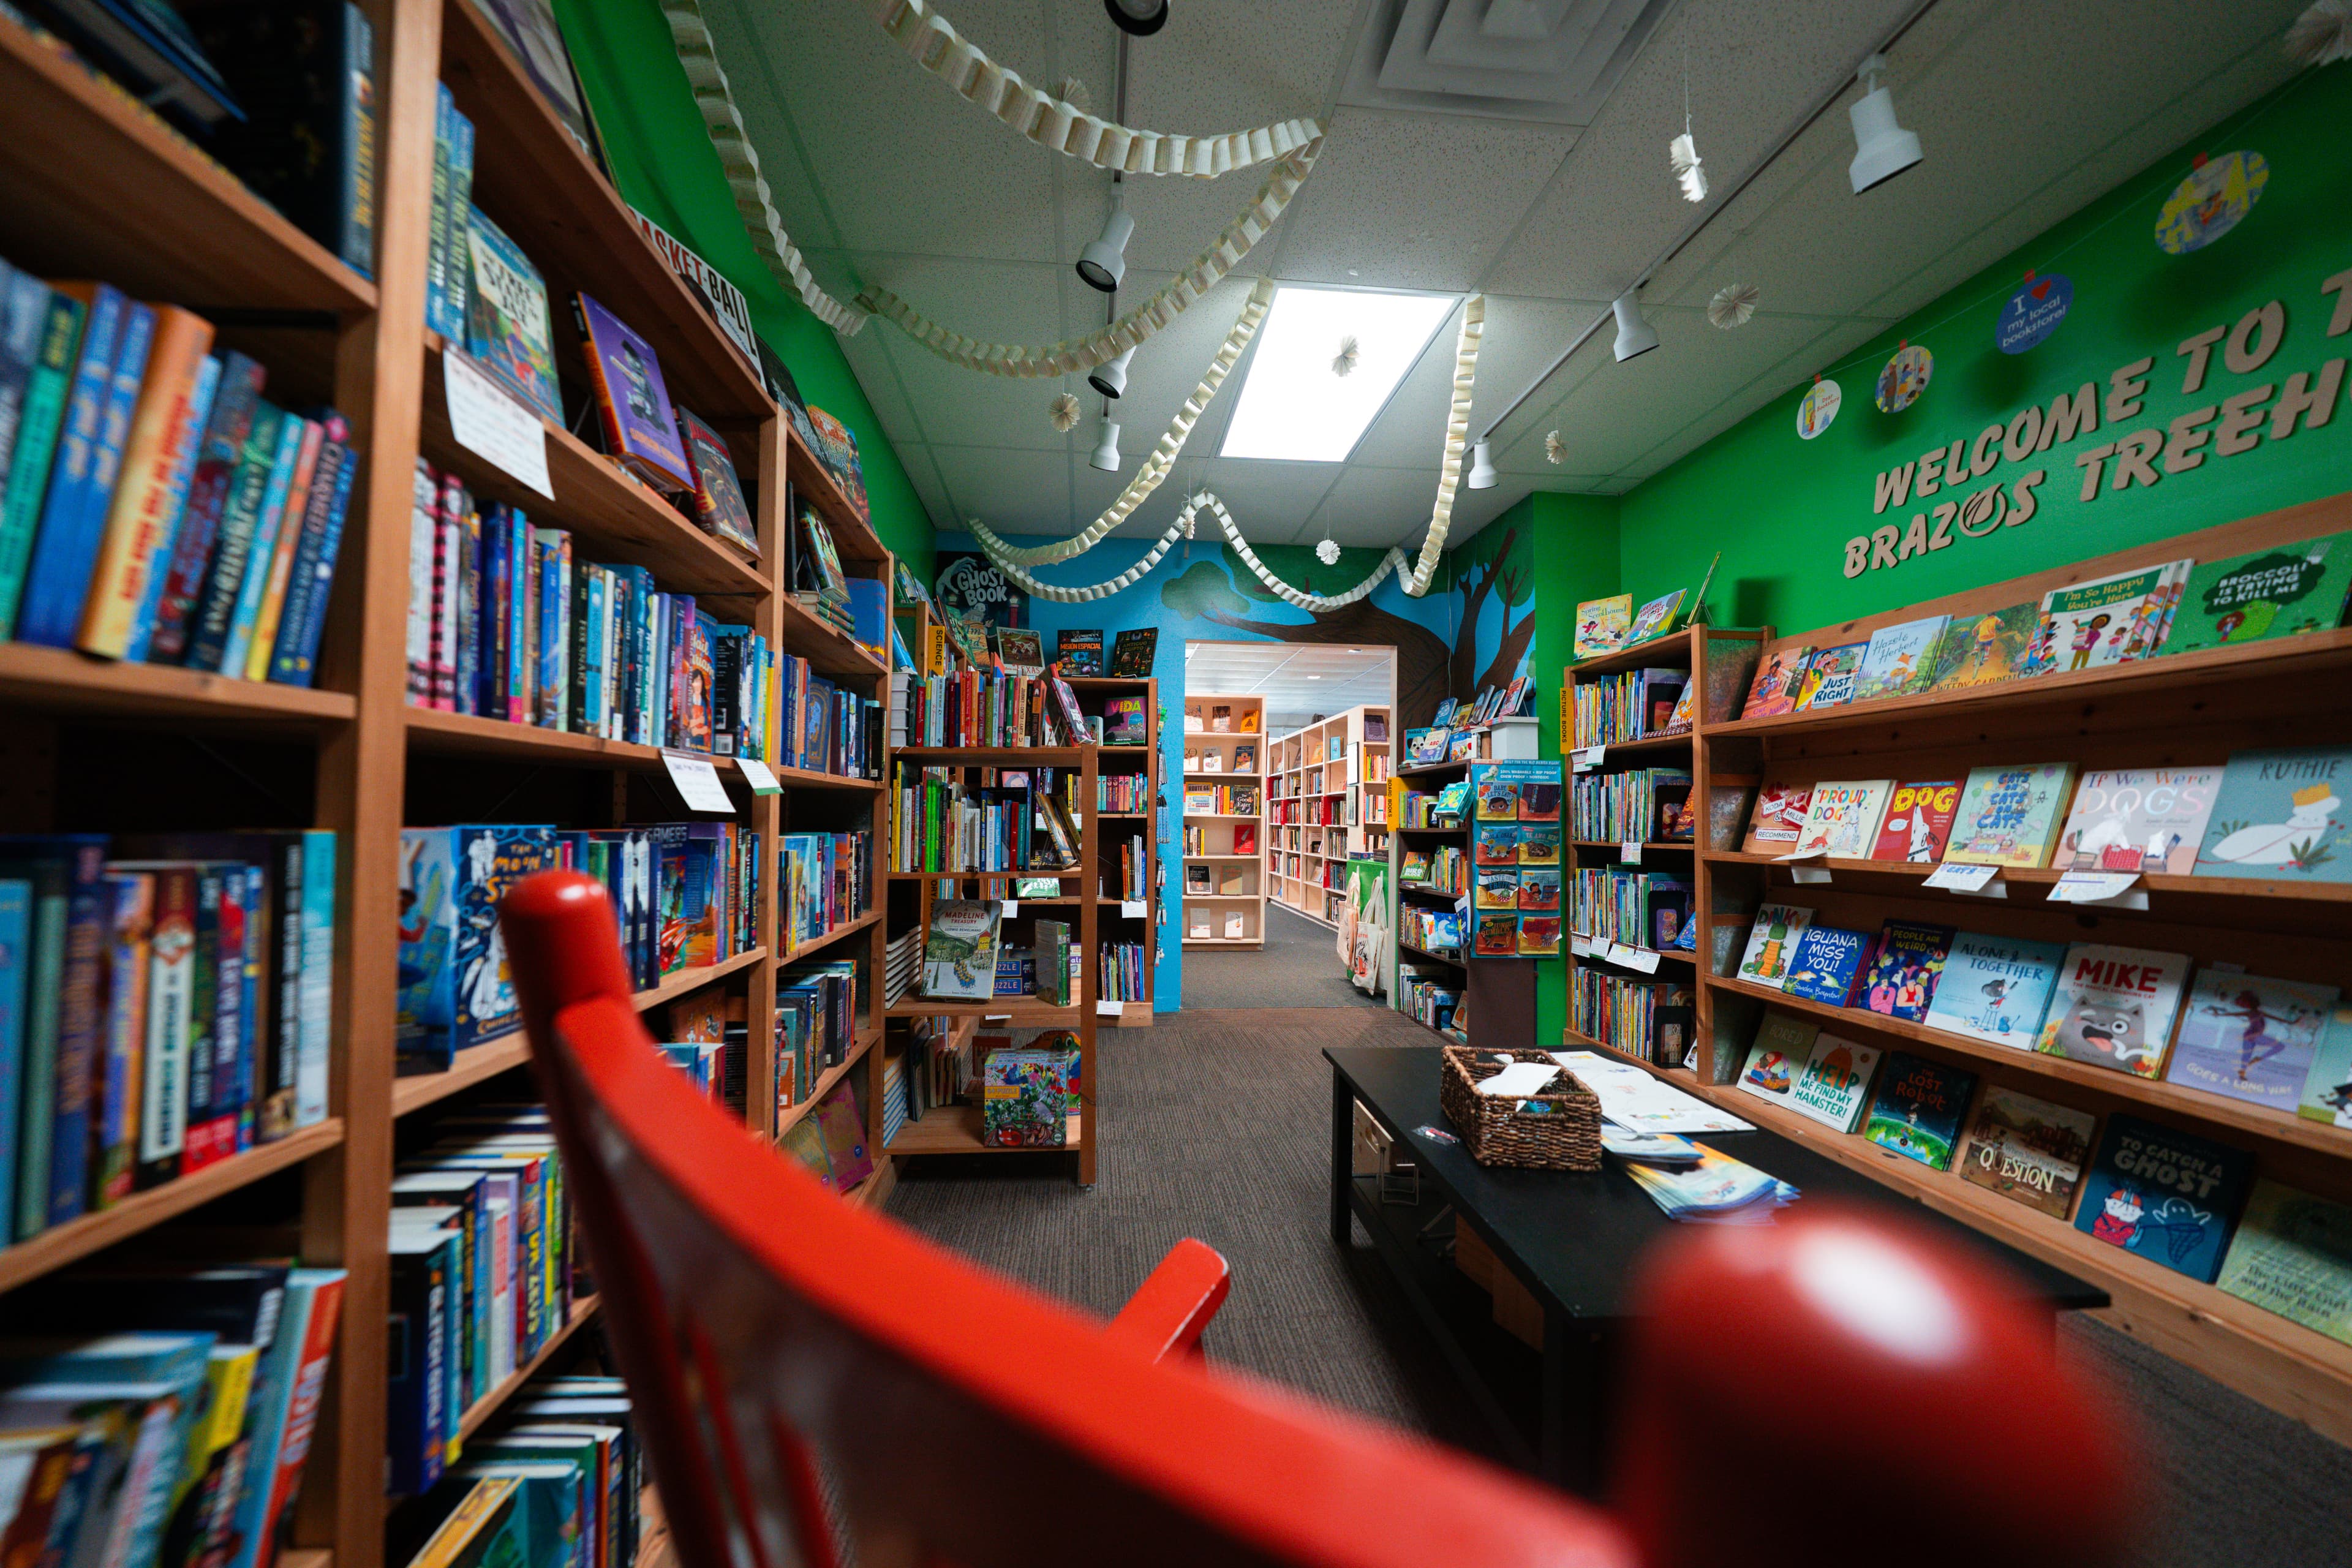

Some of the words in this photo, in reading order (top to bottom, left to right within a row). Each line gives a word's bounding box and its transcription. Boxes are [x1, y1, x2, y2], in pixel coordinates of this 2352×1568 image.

[2007, 316, 2026, 333] my
[2030, 295, 2061, 320] local
[2014, 295, 2026, 315] I
[1873, 356, 2154, 514] WELCOME
[2176, 299, 2285, 394] TO
[2075, 358, 2352, 502] TREEH
[957, 567, 1005, 591] GHOST
[2218, 561, 2309, 589] BROCCOLI
[2218, 587, 2233, 597] IS
[2236, 573, 2300, 592] TRYING
[965, 586, 1008, 606] BOOK
[2084, 589, 2100, 598] So
[2102, 576, 2145, 595] Happy
[2212, 595, 2233, 606] TO
[2236, 588, 2269, 603] KILL
[2275, 582, 2300, 595] ME
[2106, 591, 2135, 605] Here
[1640, 601, 1663, 618] SQUIRREL
[935, 629, 943, 666] SCIENCE
[1873, 632, 1902, 656] Hazel
[1879, 637, 1918, 665] Herbert
[1823, 676, 1852, 690] JUST
[1814, 687, 1851, 703] RIGHT
[1110, 700, 1142, 713] VIDA
[1768, 699, 1790, 716] Aunt
[1998, 772, 2032, 784] CATS
[2088, 773, 2108, 788] If
[2116, 772, 2144, 786] We
[2155, 771, 2211, 785] Were
[2258, 758, 2343, 781] RUTHIE
[1765, 801, 1784, 811] KODA
[1819, 789, 1868, 804] PROUD
[1893, 786, 1958, 813] DOG
[1989, 791, 2028, 805] CATS
[2077, 786, 2209, 816] DOGS
[1785, 810, 1806, 823] MILLIE
[1813, 806, 1844, 821] DOG
[1977, 813, 2026, 829] CATS
[1758, 831, 1797, 840] RECOMMEND
[1755, 906, 1807, 932] DINKY
[1804, 929, 1858, 949] IGUANA
[1893, 930, 1924, 942] PEOPLE
[1925, 935, 1942, 944] ARE
[1895, 941, 1927, 952] WEIRD
[1807, 943, 1846, 960] MISS
[1961, 943, 2007, 960] ALONE
[2009, 949, 2020, 962] &
[1806, 955, 1841, 973] YOU!
[1969, 957, 2044, 981] TOGETHER
[2075, 957, 2164, 993] MIKE
[993, 981, 1018, 990] UZZLE
[1793, 982, 1814, 993] Sandra
[1814, 986, 1841, 1000] Boynton
[1769, 1024, 1804, 1045] BORED
[1805, 1058, 1861, 1094] HELP
[1908, 1072, 1943, 1092] LOST
[1921, 1068, 1935, 1078] THE
[2186, 1062, 2220, 1082] GOES
[2233, 1079, 2265, 1094] LONG
[1799, 1078, 1814, 1092] ME
[1814, 1083, 1837, 1099] FIND
[1836, 1090, 1853, 1106] MY
[1896, 1082, 1947, 1112] Robot
[1793, 1088, 1849, 1119] HAMSTER!
[2120, 1136, 2143, 1150] TO
[2144, 1141, 2207, 1174] CATCH
[2209, 1163, 2223, 1179] A
[1979, 1146, 2056, 1194] QUESTION
[2113, 1148, 2221, 1199] GHOST
